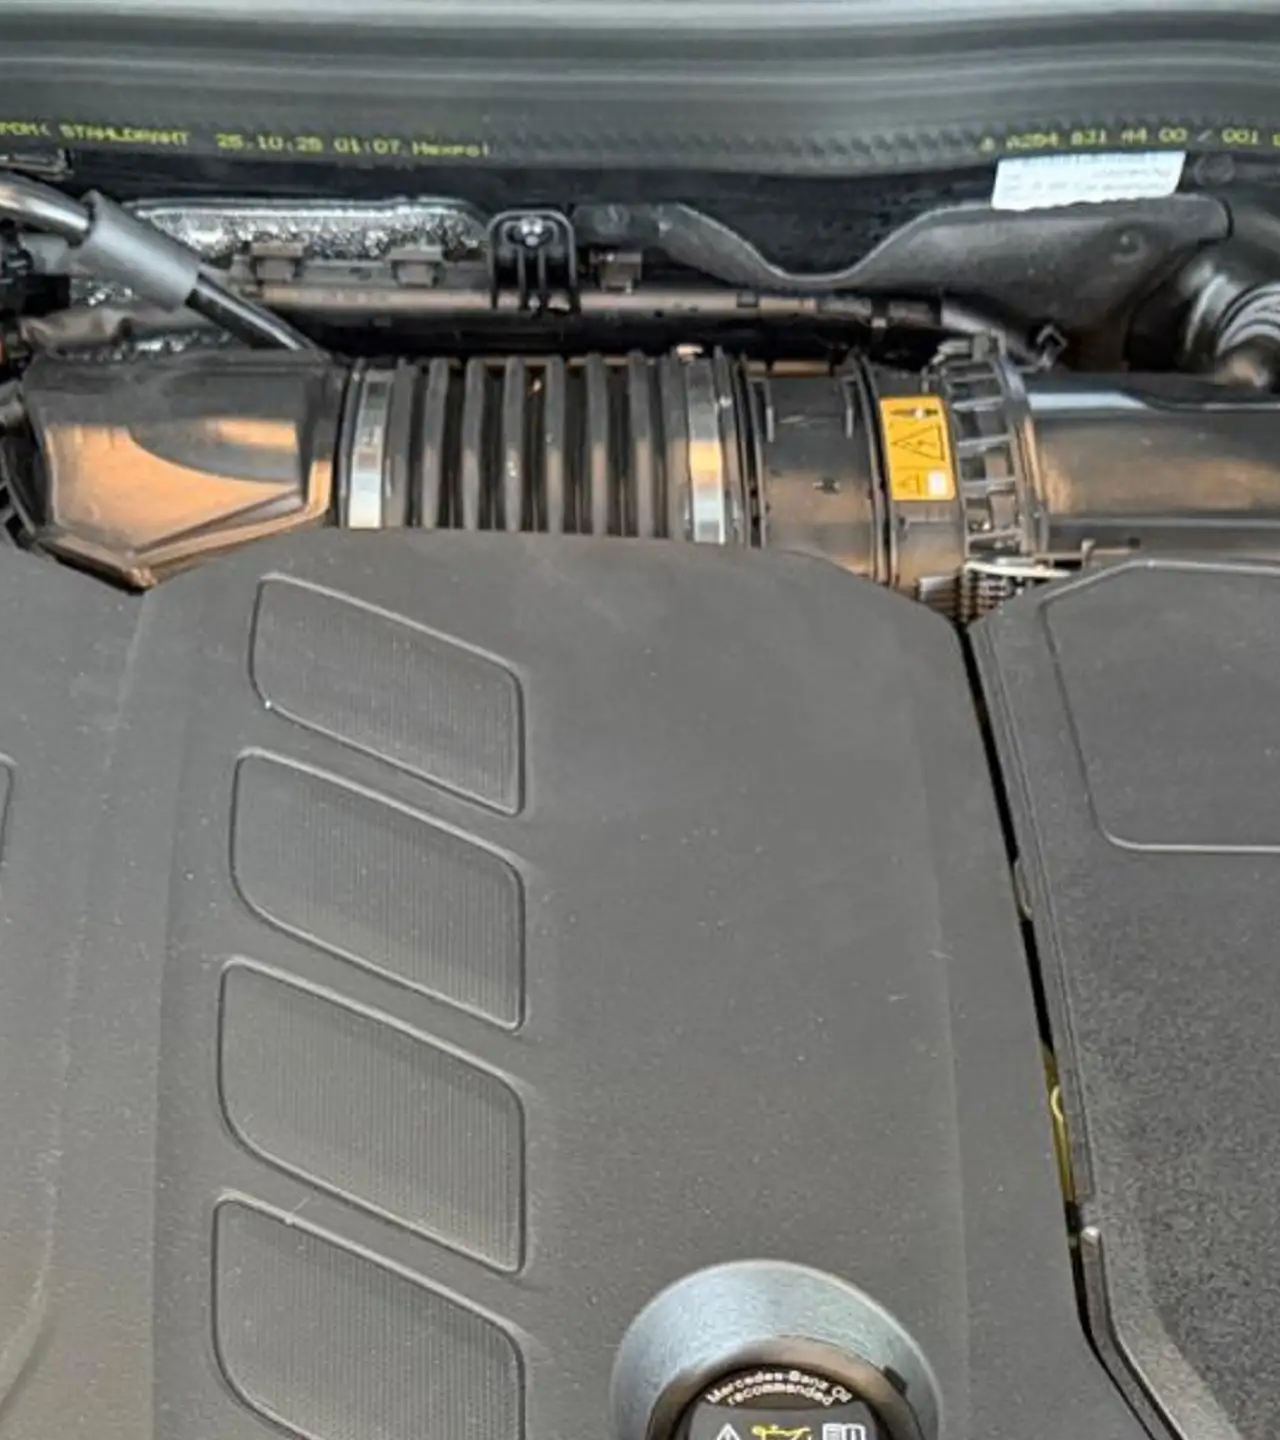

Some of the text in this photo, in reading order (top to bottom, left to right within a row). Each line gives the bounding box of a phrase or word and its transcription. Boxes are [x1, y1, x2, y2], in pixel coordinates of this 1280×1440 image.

[1157, 126, 1189, 143] 00
[1196, 128, 1214, 143] /
[1221, 127, 1259, 146] 001
[726, 1381, 834, 1407] recommended
